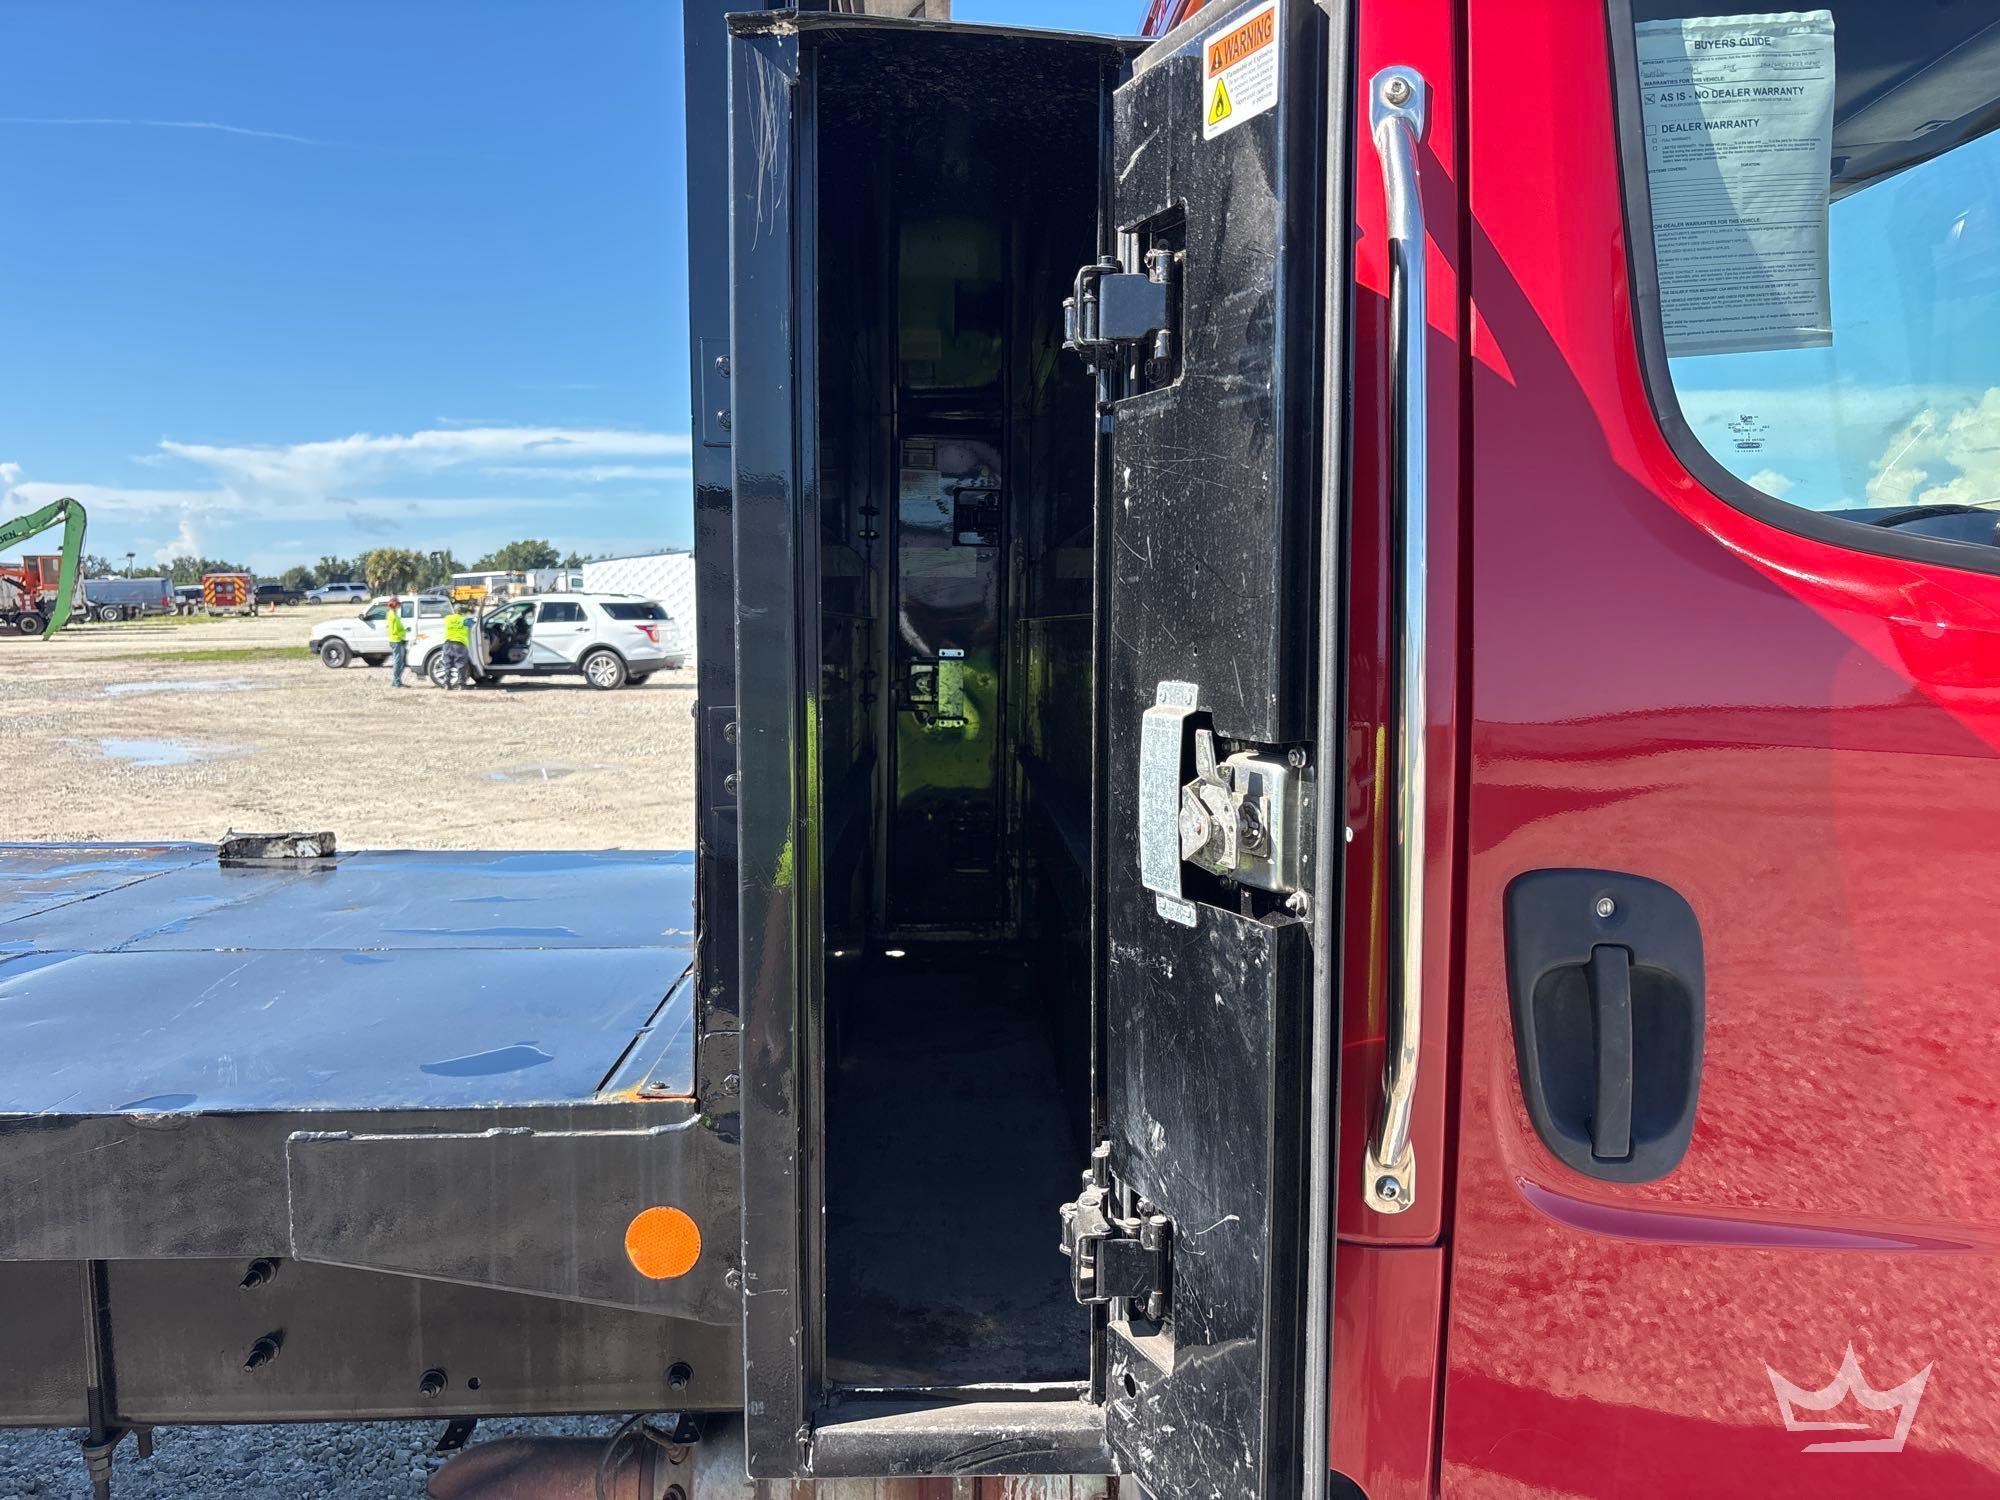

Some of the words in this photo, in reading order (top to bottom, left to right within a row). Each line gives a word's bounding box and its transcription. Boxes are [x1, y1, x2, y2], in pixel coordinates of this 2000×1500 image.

[1224, 15, 1271, 64] WARNING
[1694, 38, 1736, 50] BUYERS
[1739, 36, 1771, 47] GUIDE
[1660, 92, 1674, 103] AS
[1676, 91, 1686, 101] IS
[1694, 90, 1709, 100] NO
[1711, 88, 1751, 99] DEALER
[1752, 86, 1804, 97] WARRANTY
[1661, 122, 1702, 134] DEALER
[1703, 118, 1760, 130] WARRANTY
